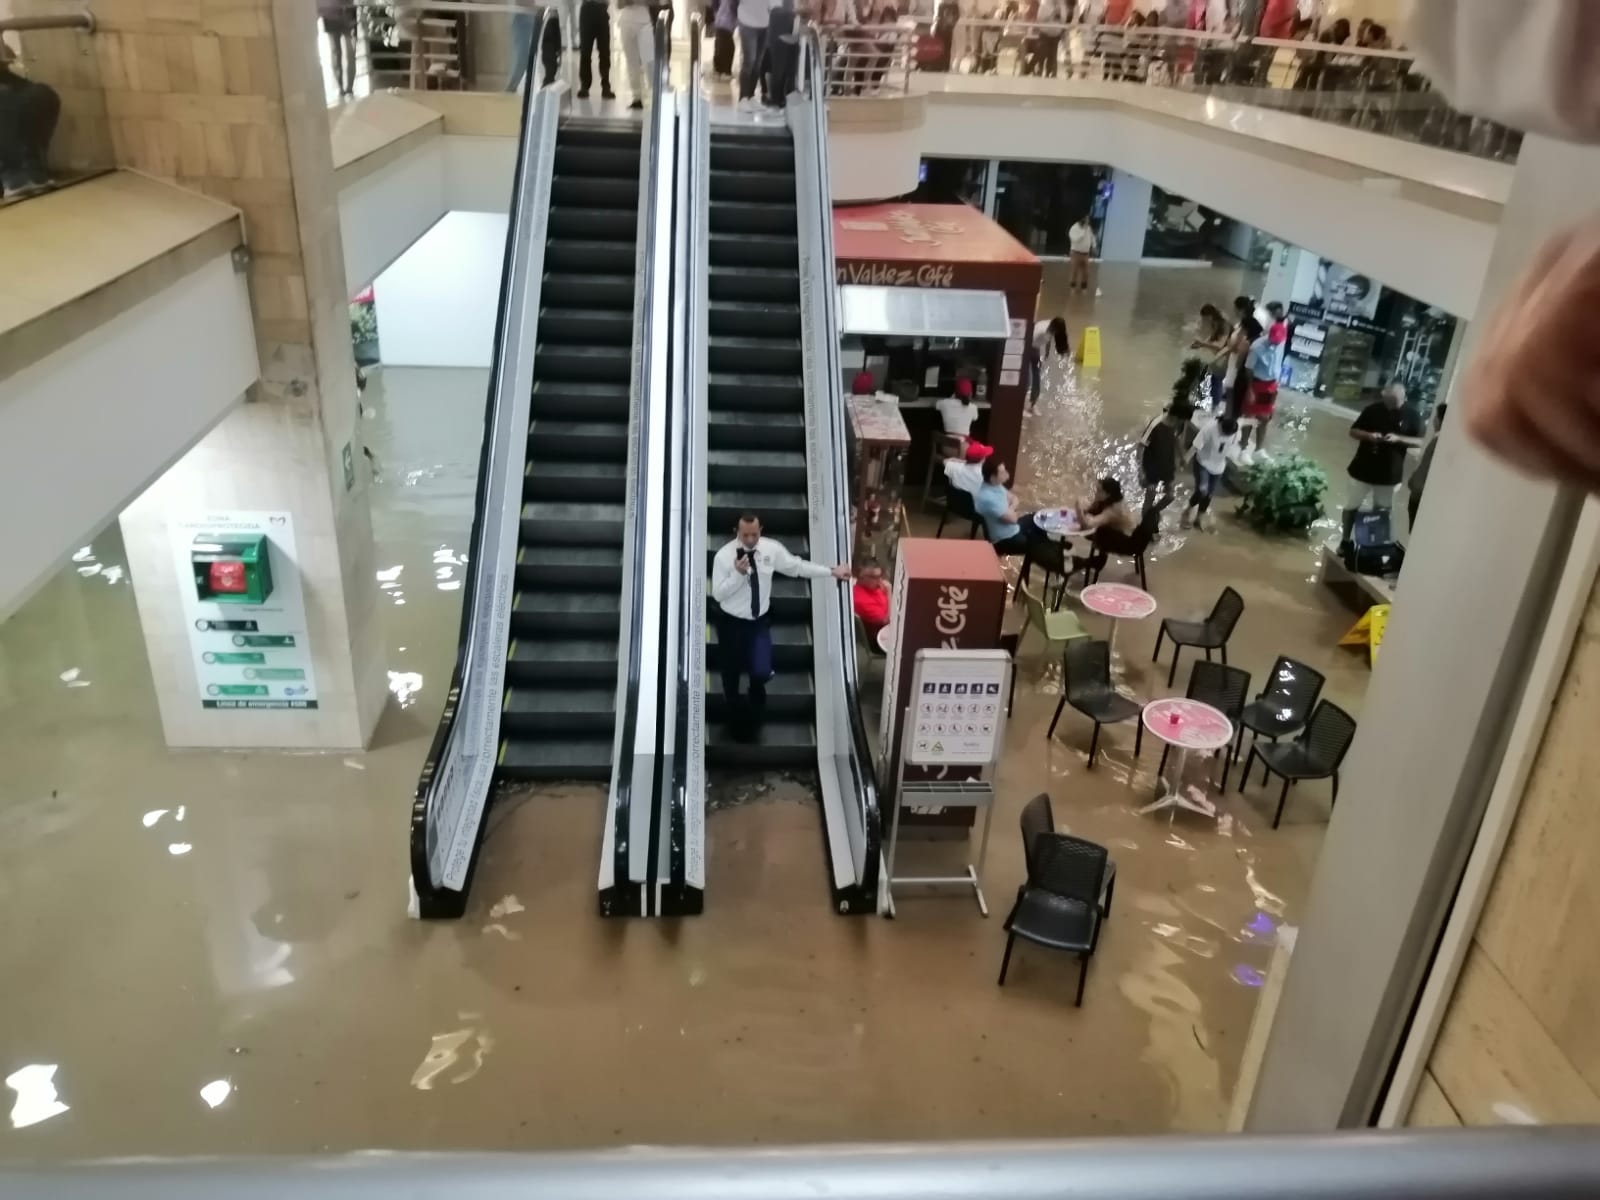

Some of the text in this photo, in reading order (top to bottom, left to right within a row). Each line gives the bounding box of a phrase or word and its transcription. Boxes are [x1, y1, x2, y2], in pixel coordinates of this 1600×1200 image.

[849, 263, 914, 285] Valdez
[916, 264, 953, 288] Café
[935, 585, 969, 635] Café
